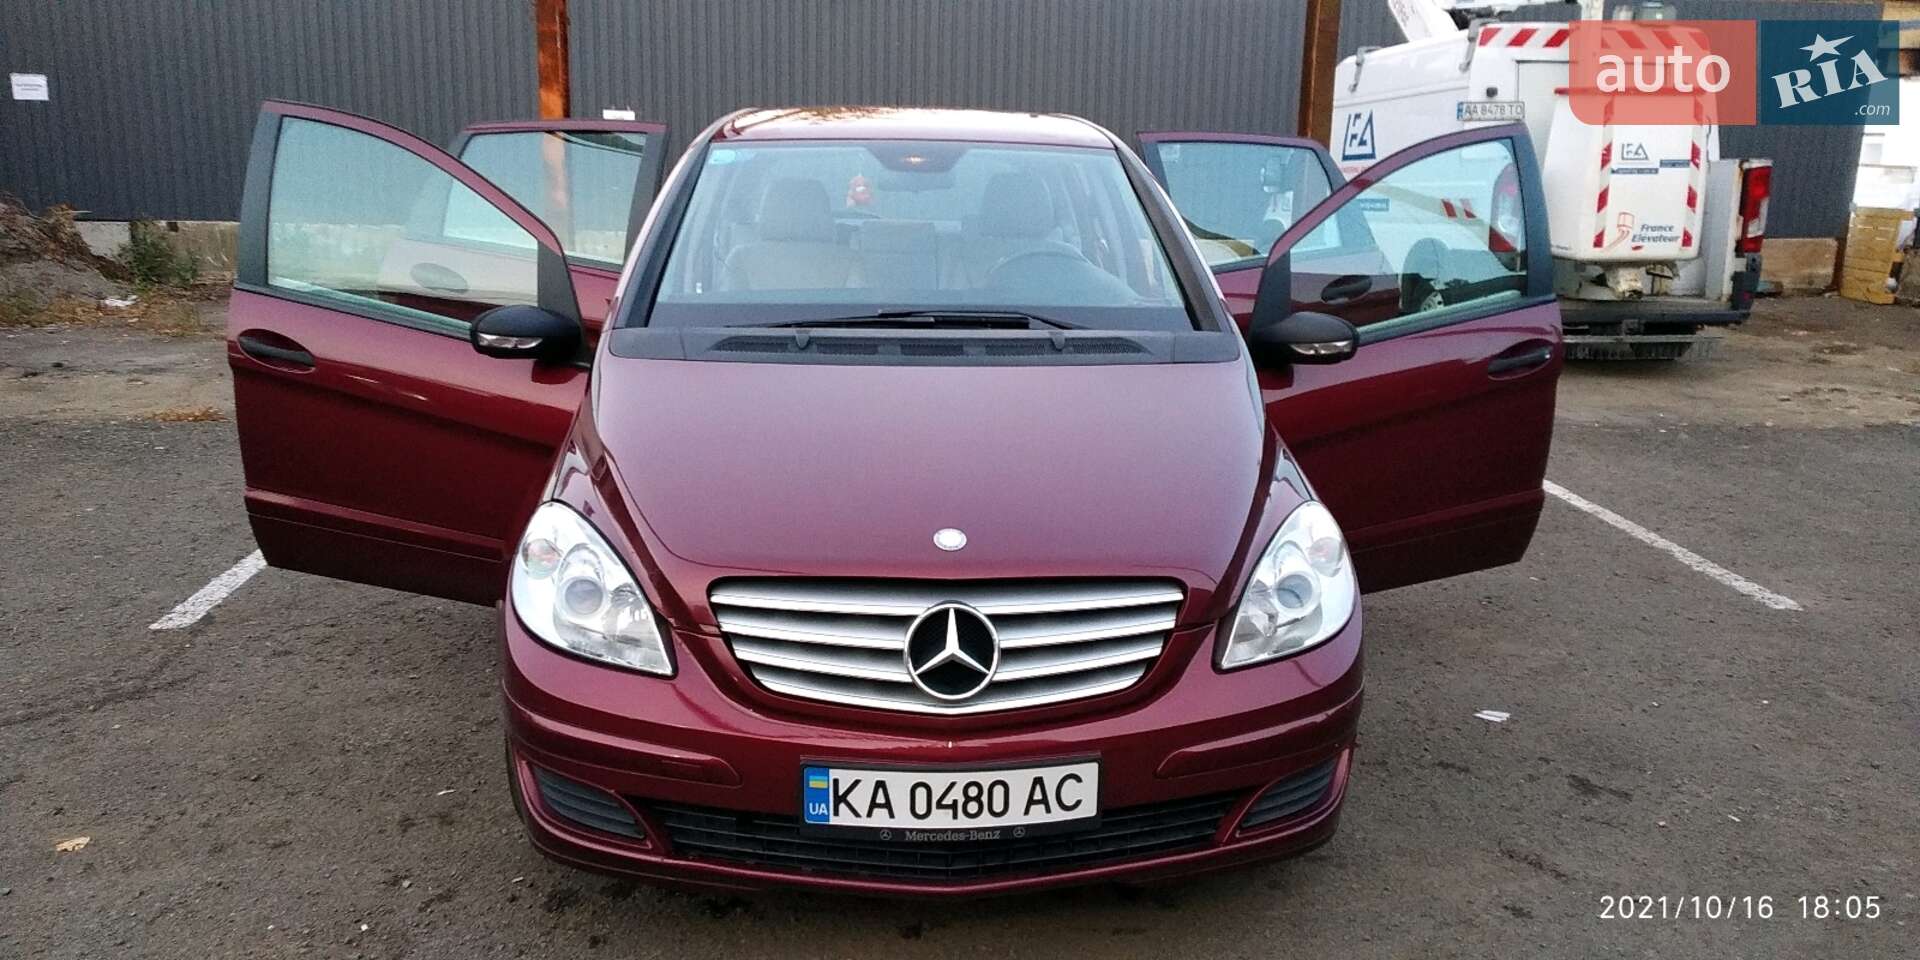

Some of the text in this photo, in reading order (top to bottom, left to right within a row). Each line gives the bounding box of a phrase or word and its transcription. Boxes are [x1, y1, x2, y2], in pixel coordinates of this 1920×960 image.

[1640, 223, 1674, 233] France
[832, 772, 1083, 820] KA 0480 AC
[809, 802, 828, 815] UA
[905, 829, 1000, 842] Mercedes-Benz
